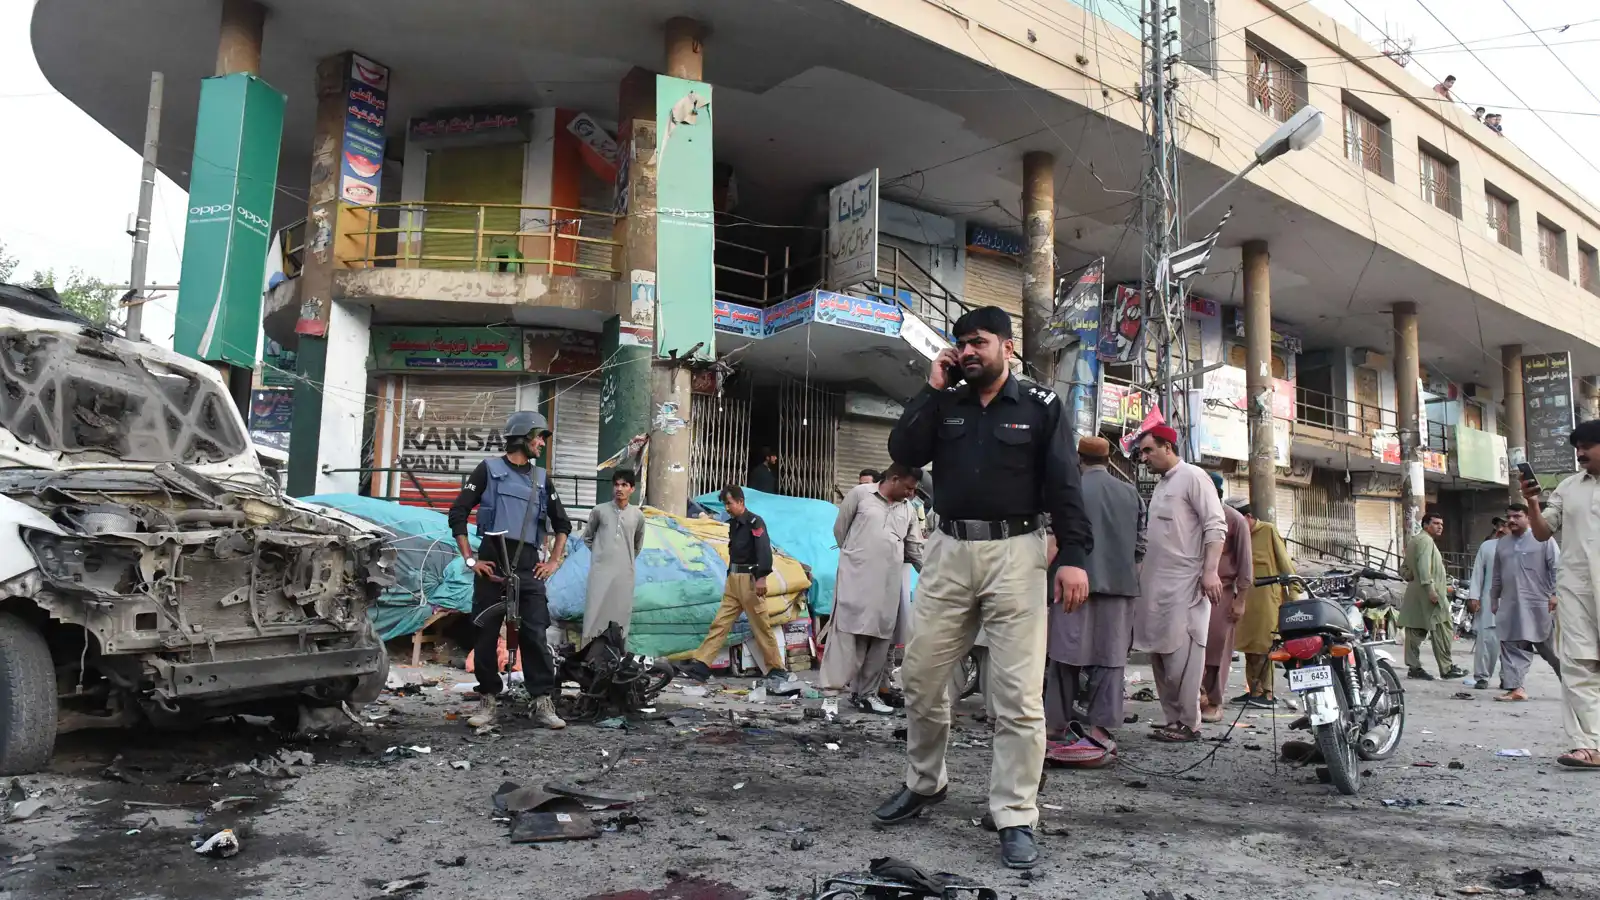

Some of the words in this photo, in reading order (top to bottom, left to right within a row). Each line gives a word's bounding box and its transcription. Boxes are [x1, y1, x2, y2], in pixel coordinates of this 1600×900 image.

[190, 204, 231, 215] oppo
[660, 206, 710, 219] oppo
[237, 206, 269, 228] oppo
[403, 426, 506, 451] KANSA
[400, 455, 465, 471] PAINT
[1311, 671, 1329, 681] 6453
